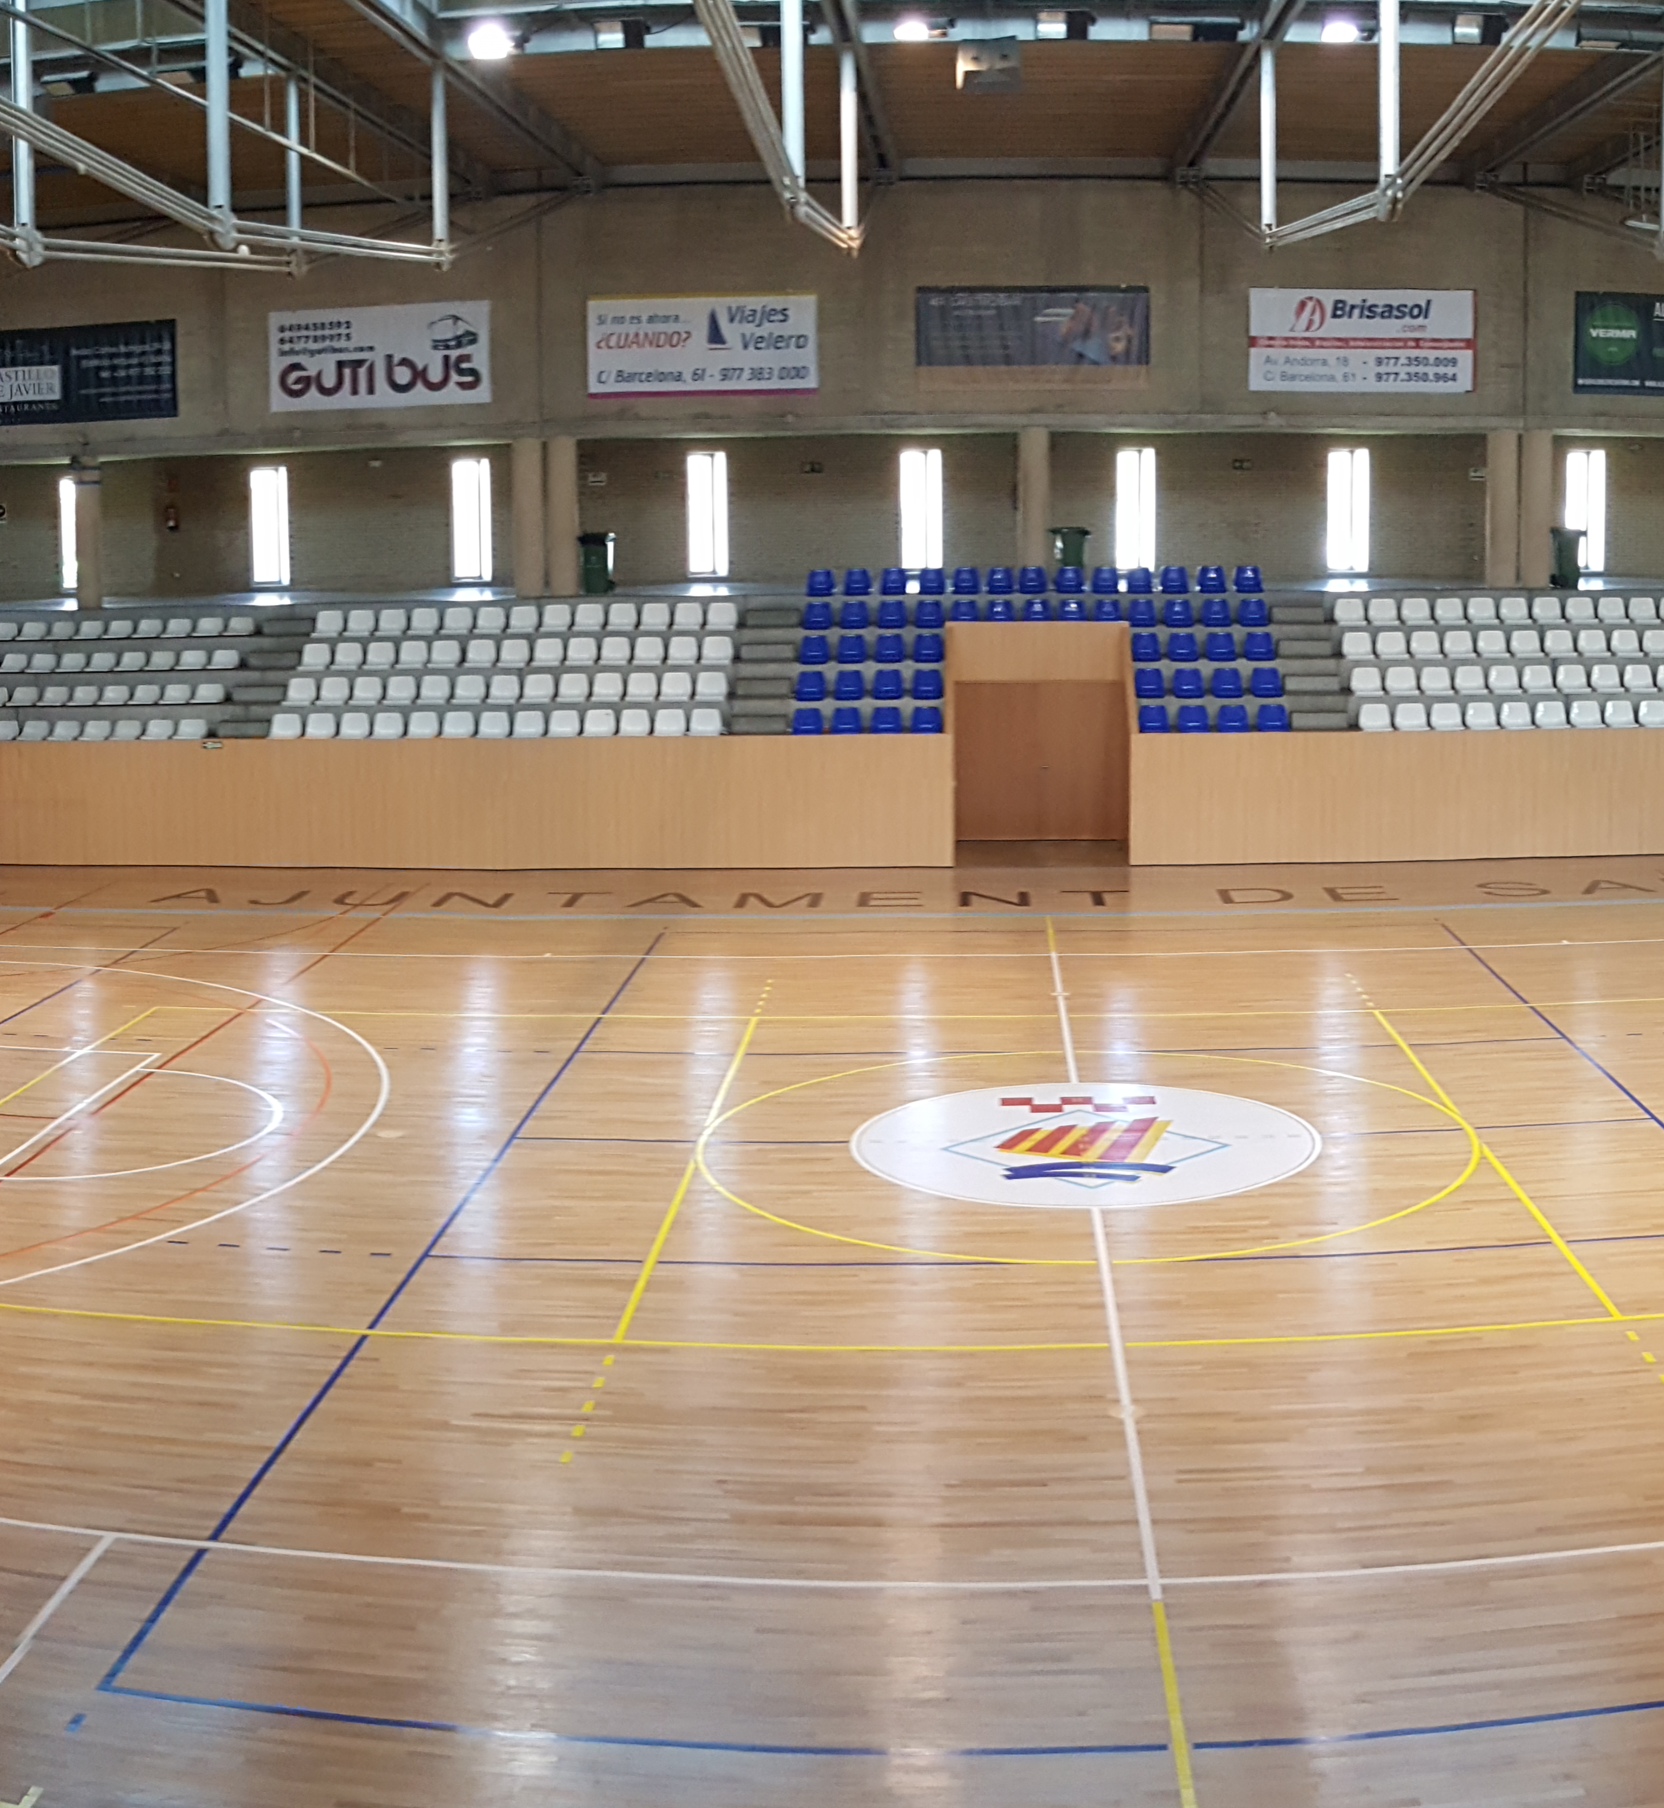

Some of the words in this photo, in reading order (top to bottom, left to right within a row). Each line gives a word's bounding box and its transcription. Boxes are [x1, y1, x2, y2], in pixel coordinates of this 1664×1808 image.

[727, 304, 789, 327] Viajes
[1330, 299, 1432, 320] Brisasol
[611, 315, 627, 325] no
[630, 315, 642, 324] es
[741, 331, 809, 350] Velero
[615, 368, 686, 384] Barcelona,
[719, 367, 744, 382] 977
[9, 382, 57, 401] JAVIER
[150, 887, 1129, 909] AJUNTAMENT
[1215, 886, 1399, 905] DE
